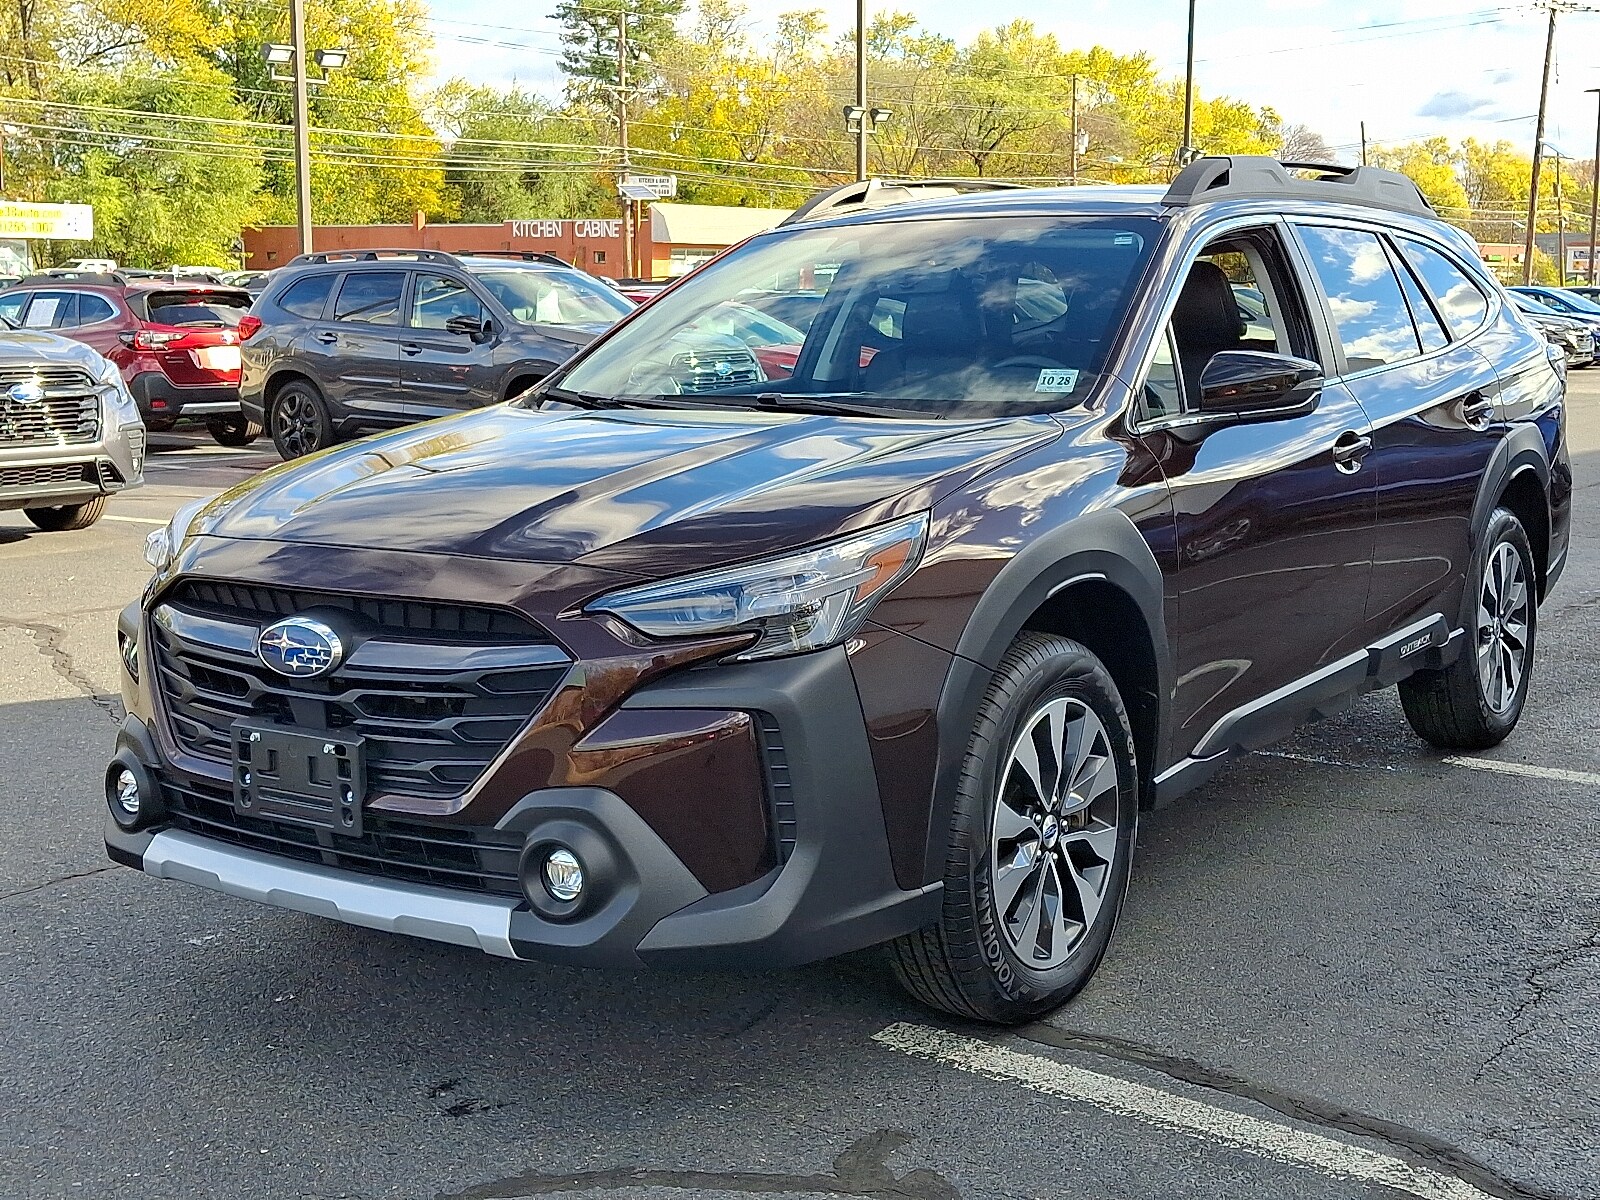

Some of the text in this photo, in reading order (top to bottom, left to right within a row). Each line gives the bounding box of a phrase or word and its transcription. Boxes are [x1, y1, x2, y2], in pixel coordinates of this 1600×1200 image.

[512, 221, 562, 238] KITCHEN
[1041, 376, 1071, 386] 10 28
[1400, 632, 1430, 655] OUTBACK
[976, 866, 1016, 994] YOKOHAMA
